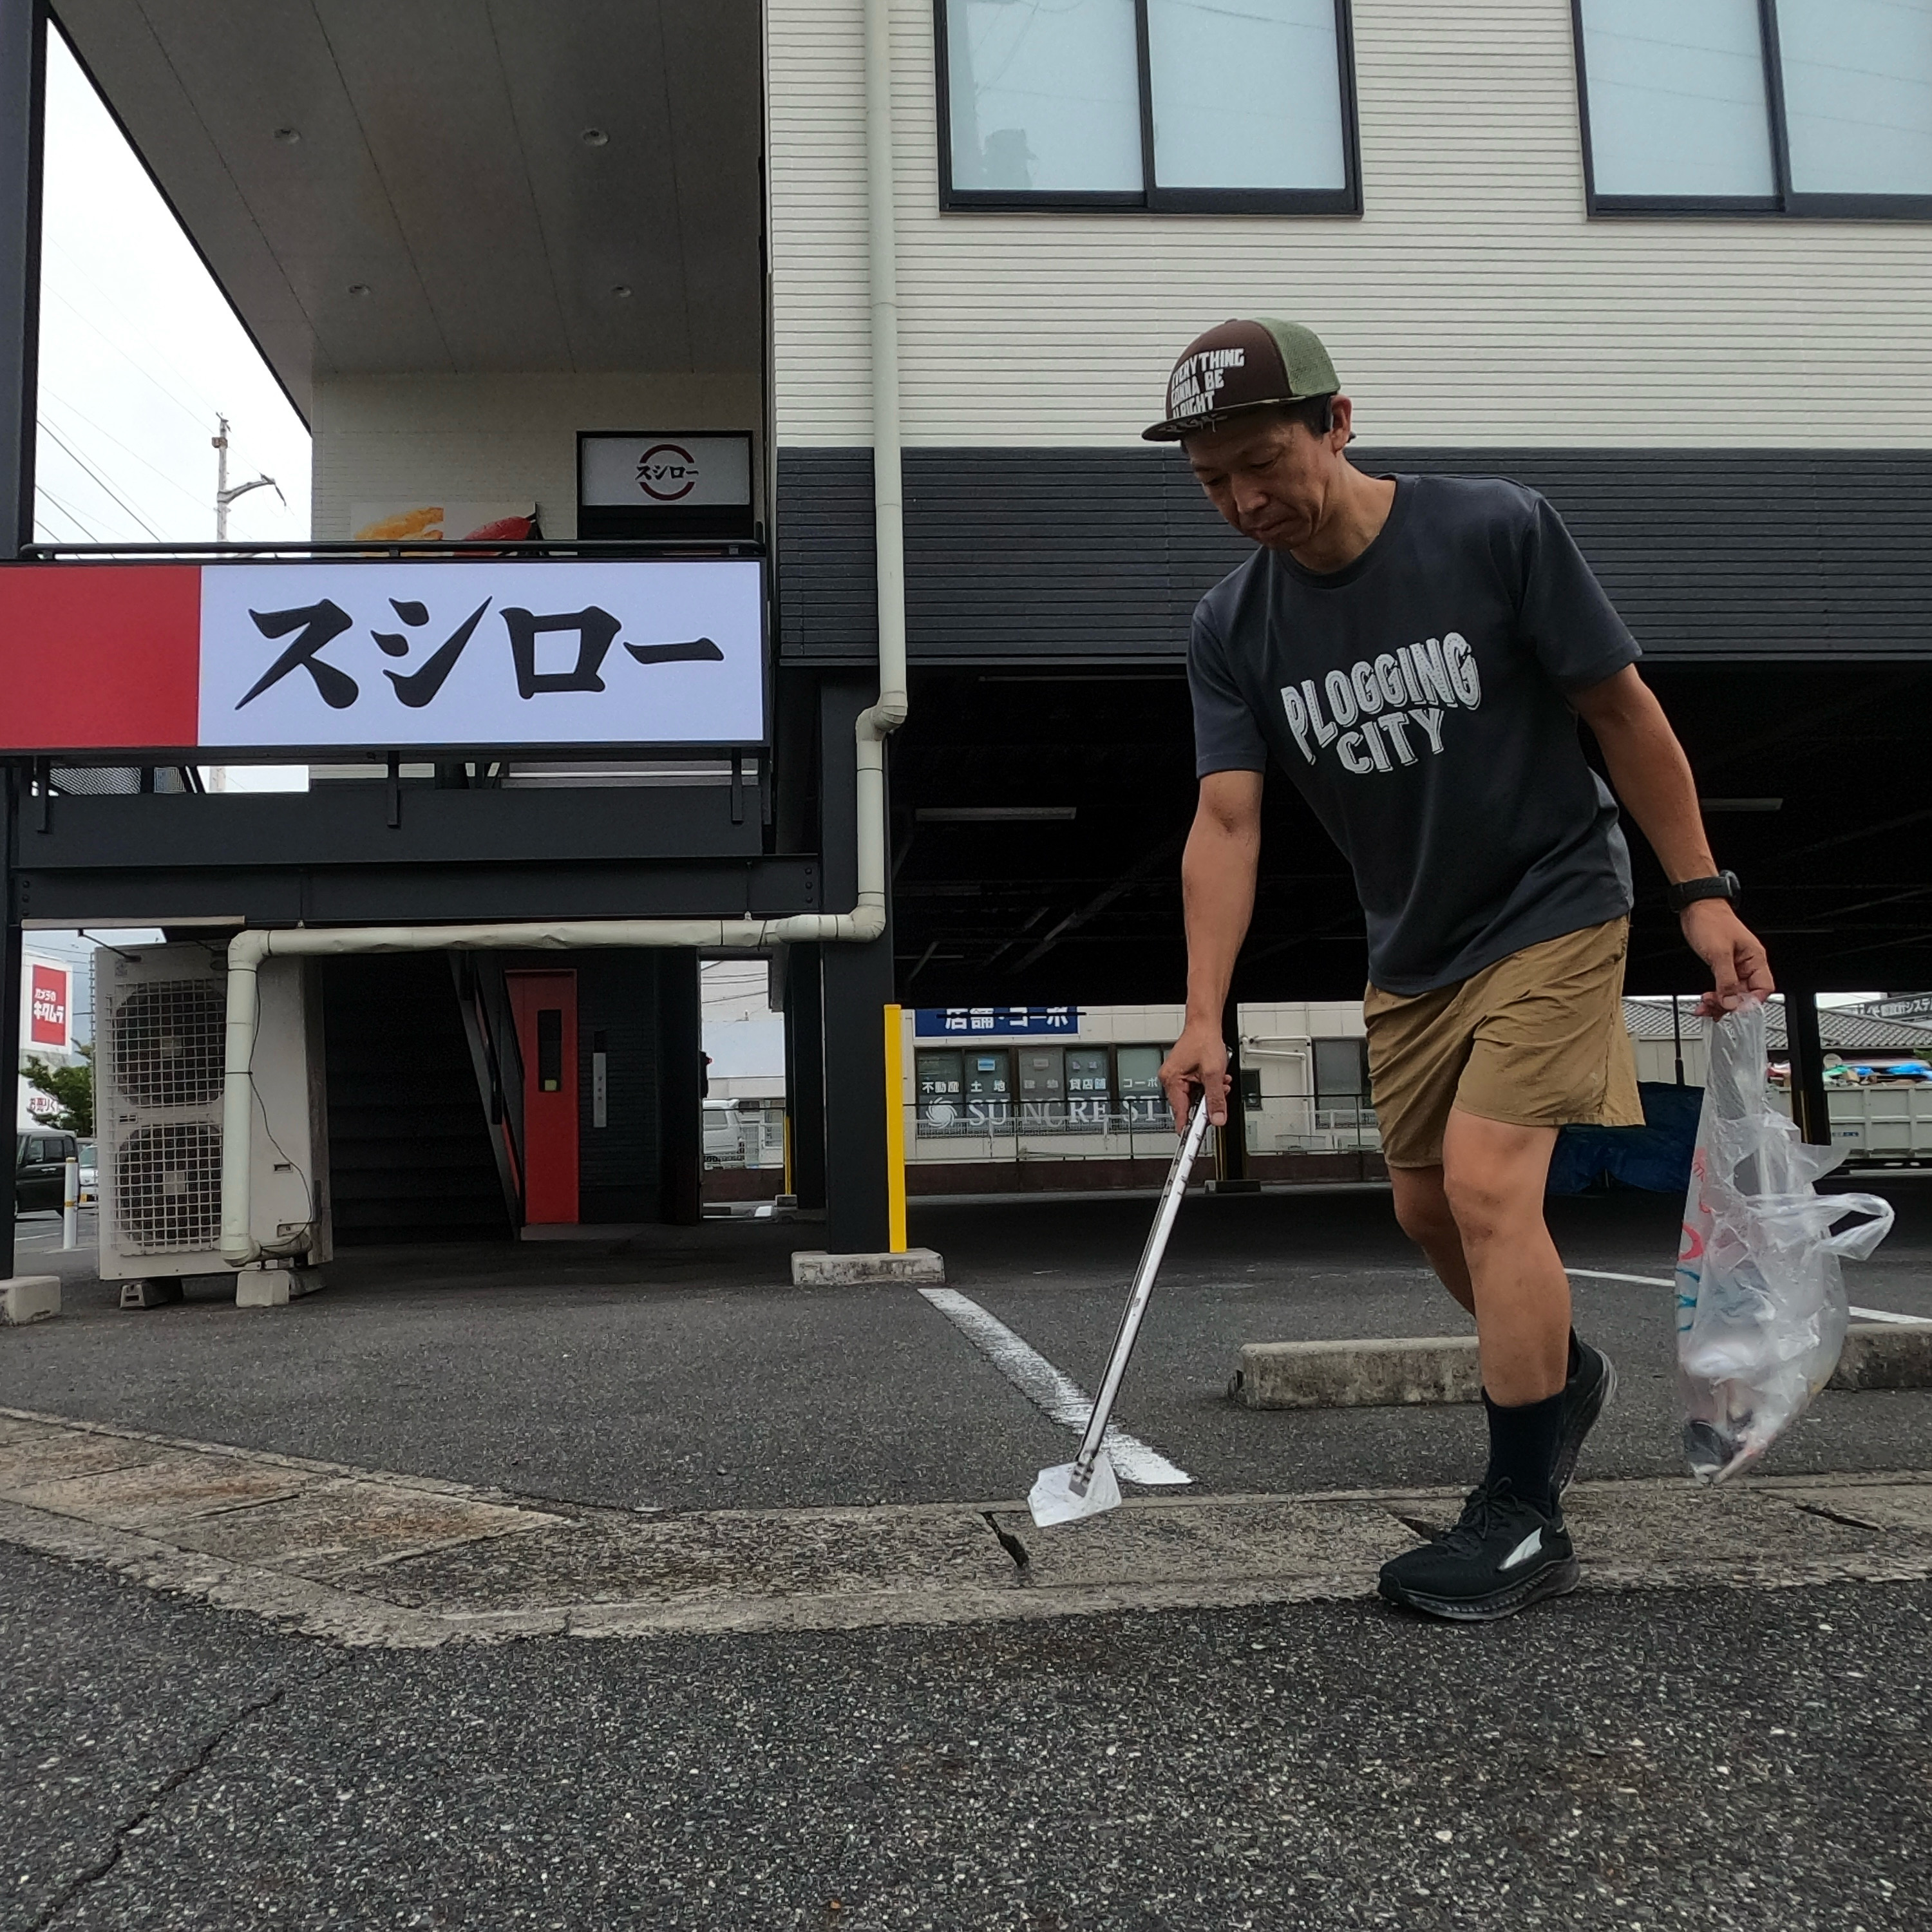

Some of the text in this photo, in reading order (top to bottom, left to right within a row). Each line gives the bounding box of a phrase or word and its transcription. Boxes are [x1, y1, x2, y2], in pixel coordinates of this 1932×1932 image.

[1204, 368, 1224, 392] BE
[635, 465, 699, 480] スシロー
[234, 596, 724, 710] スシロー
[1281, 632, 1481, 765] PLOGGING
[1336, 708, 1444, 773] CITY
[969, 1095, 1174, 1128] SUNCREST
